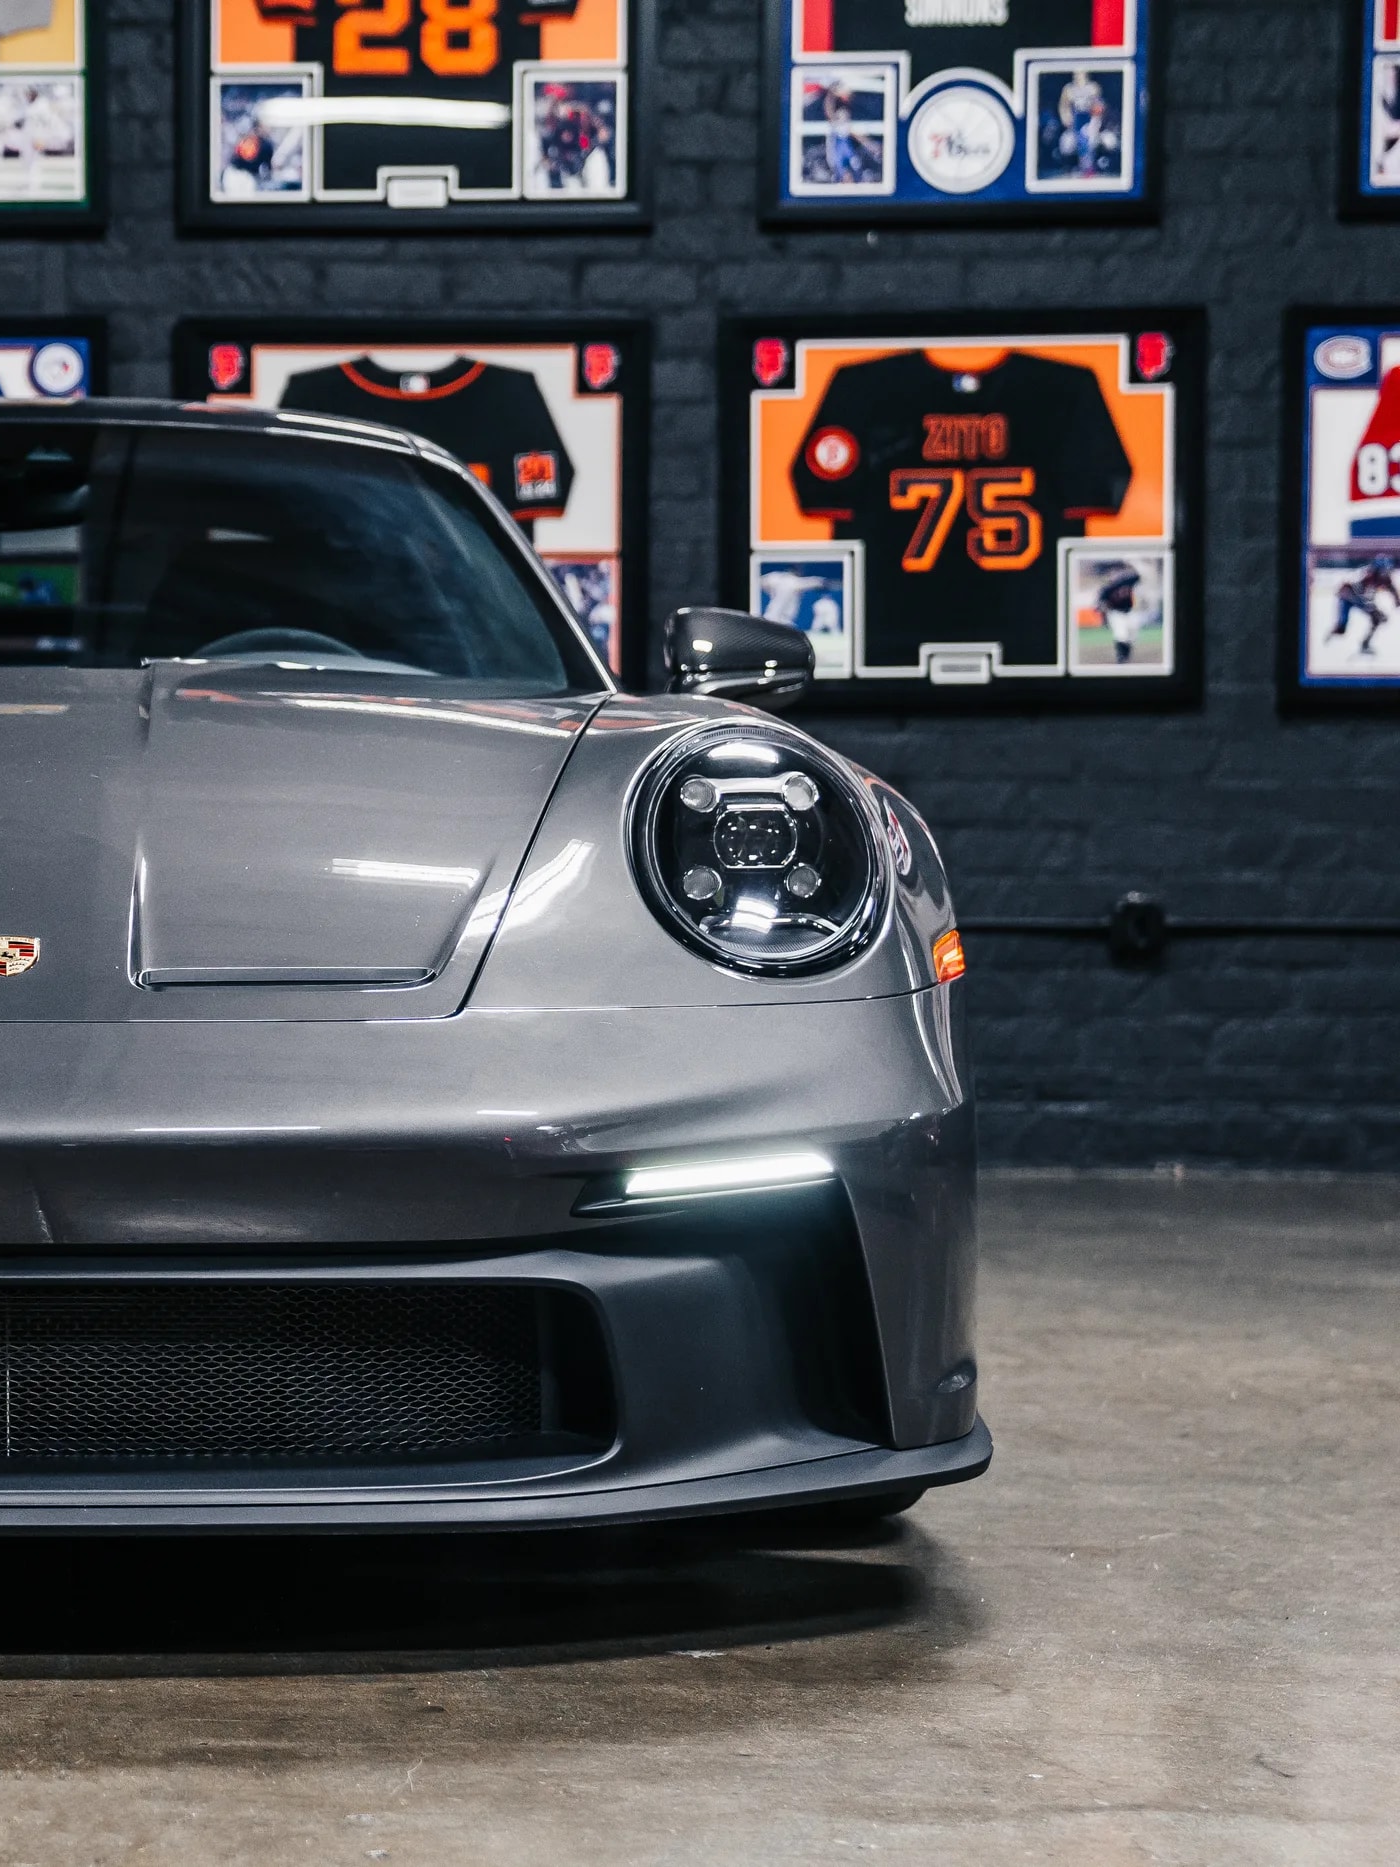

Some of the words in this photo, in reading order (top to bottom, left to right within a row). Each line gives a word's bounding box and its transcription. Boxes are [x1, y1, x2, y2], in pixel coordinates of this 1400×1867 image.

[333, 0, 498, 76] 28
[922, 412, 1008, 461] ZITO
[889, 467, 1043, 572] 75
